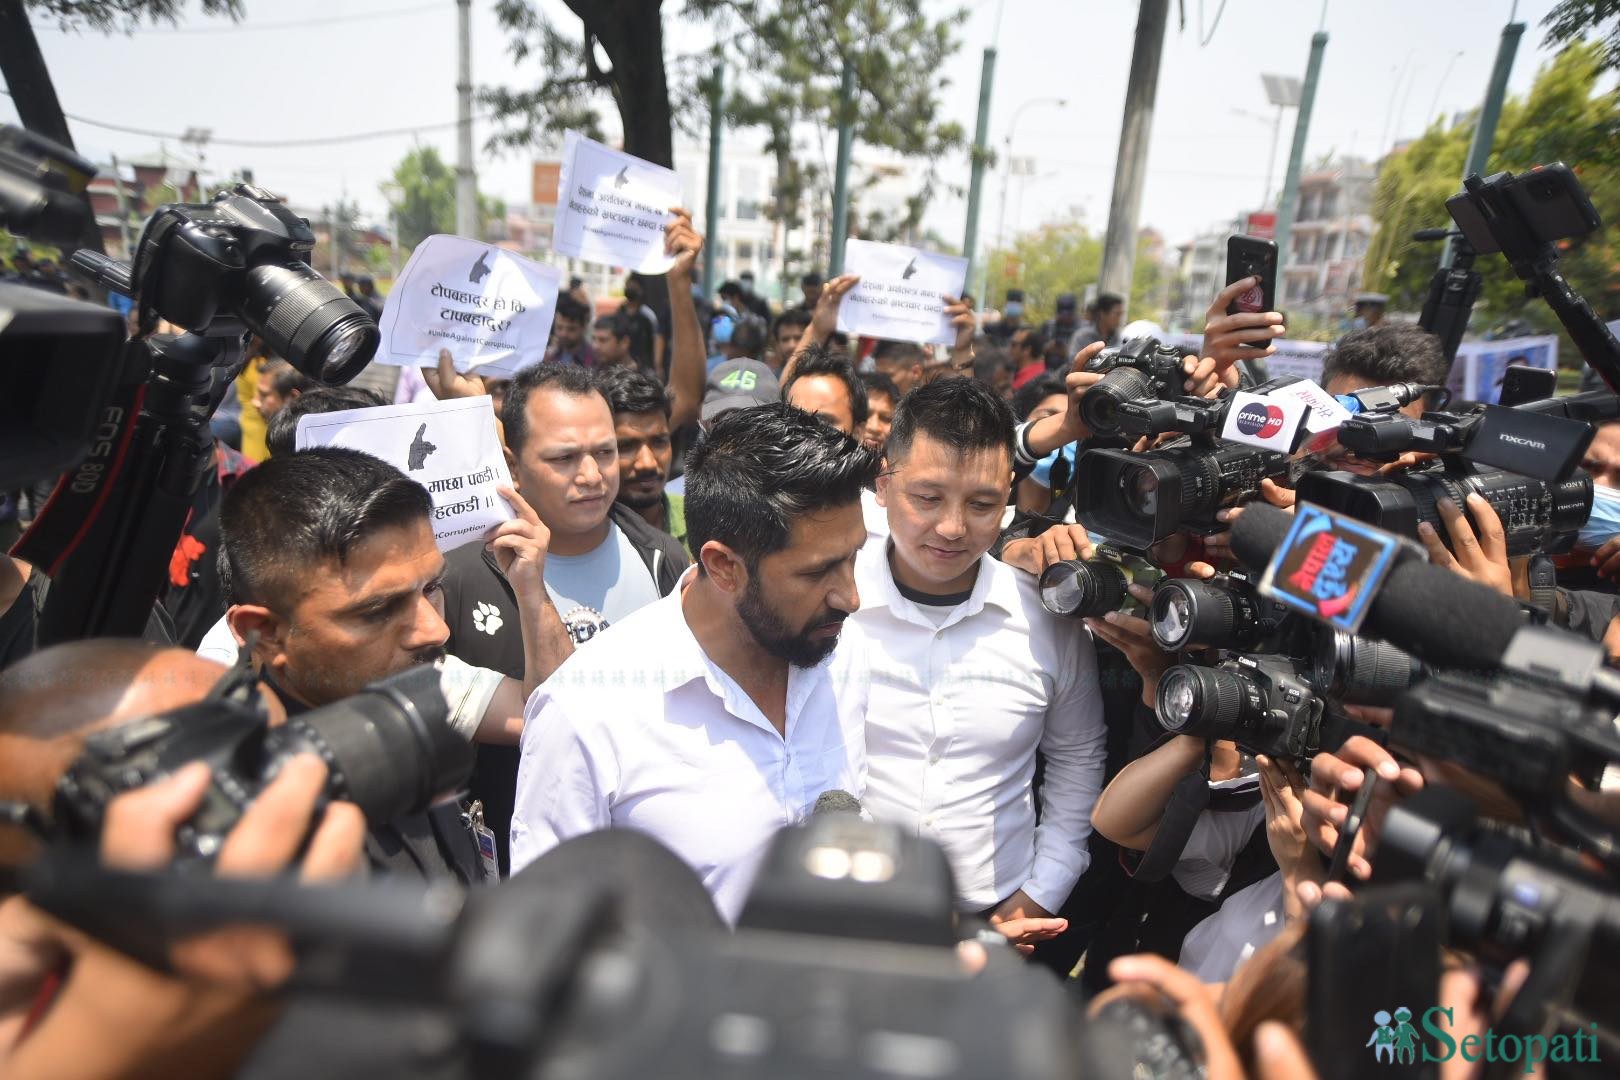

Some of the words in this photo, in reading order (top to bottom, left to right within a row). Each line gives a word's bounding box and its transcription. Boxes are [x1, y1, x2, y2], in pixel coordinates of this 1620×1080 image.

[430, 281, 488, 308] टोपबहादुर
[511, 298, 526, 313] कि
[719, 369, 757, 390] 46
[1238, 411, 1267, 424] prime
[1267, 417, 1283, 427] HD
[87, 406, 124, 457] EOS
[428, 476, 464, 493] माछा
[1229, 570, 1247, 581] Canon
[1238, 655, 1257, 669] Canon
